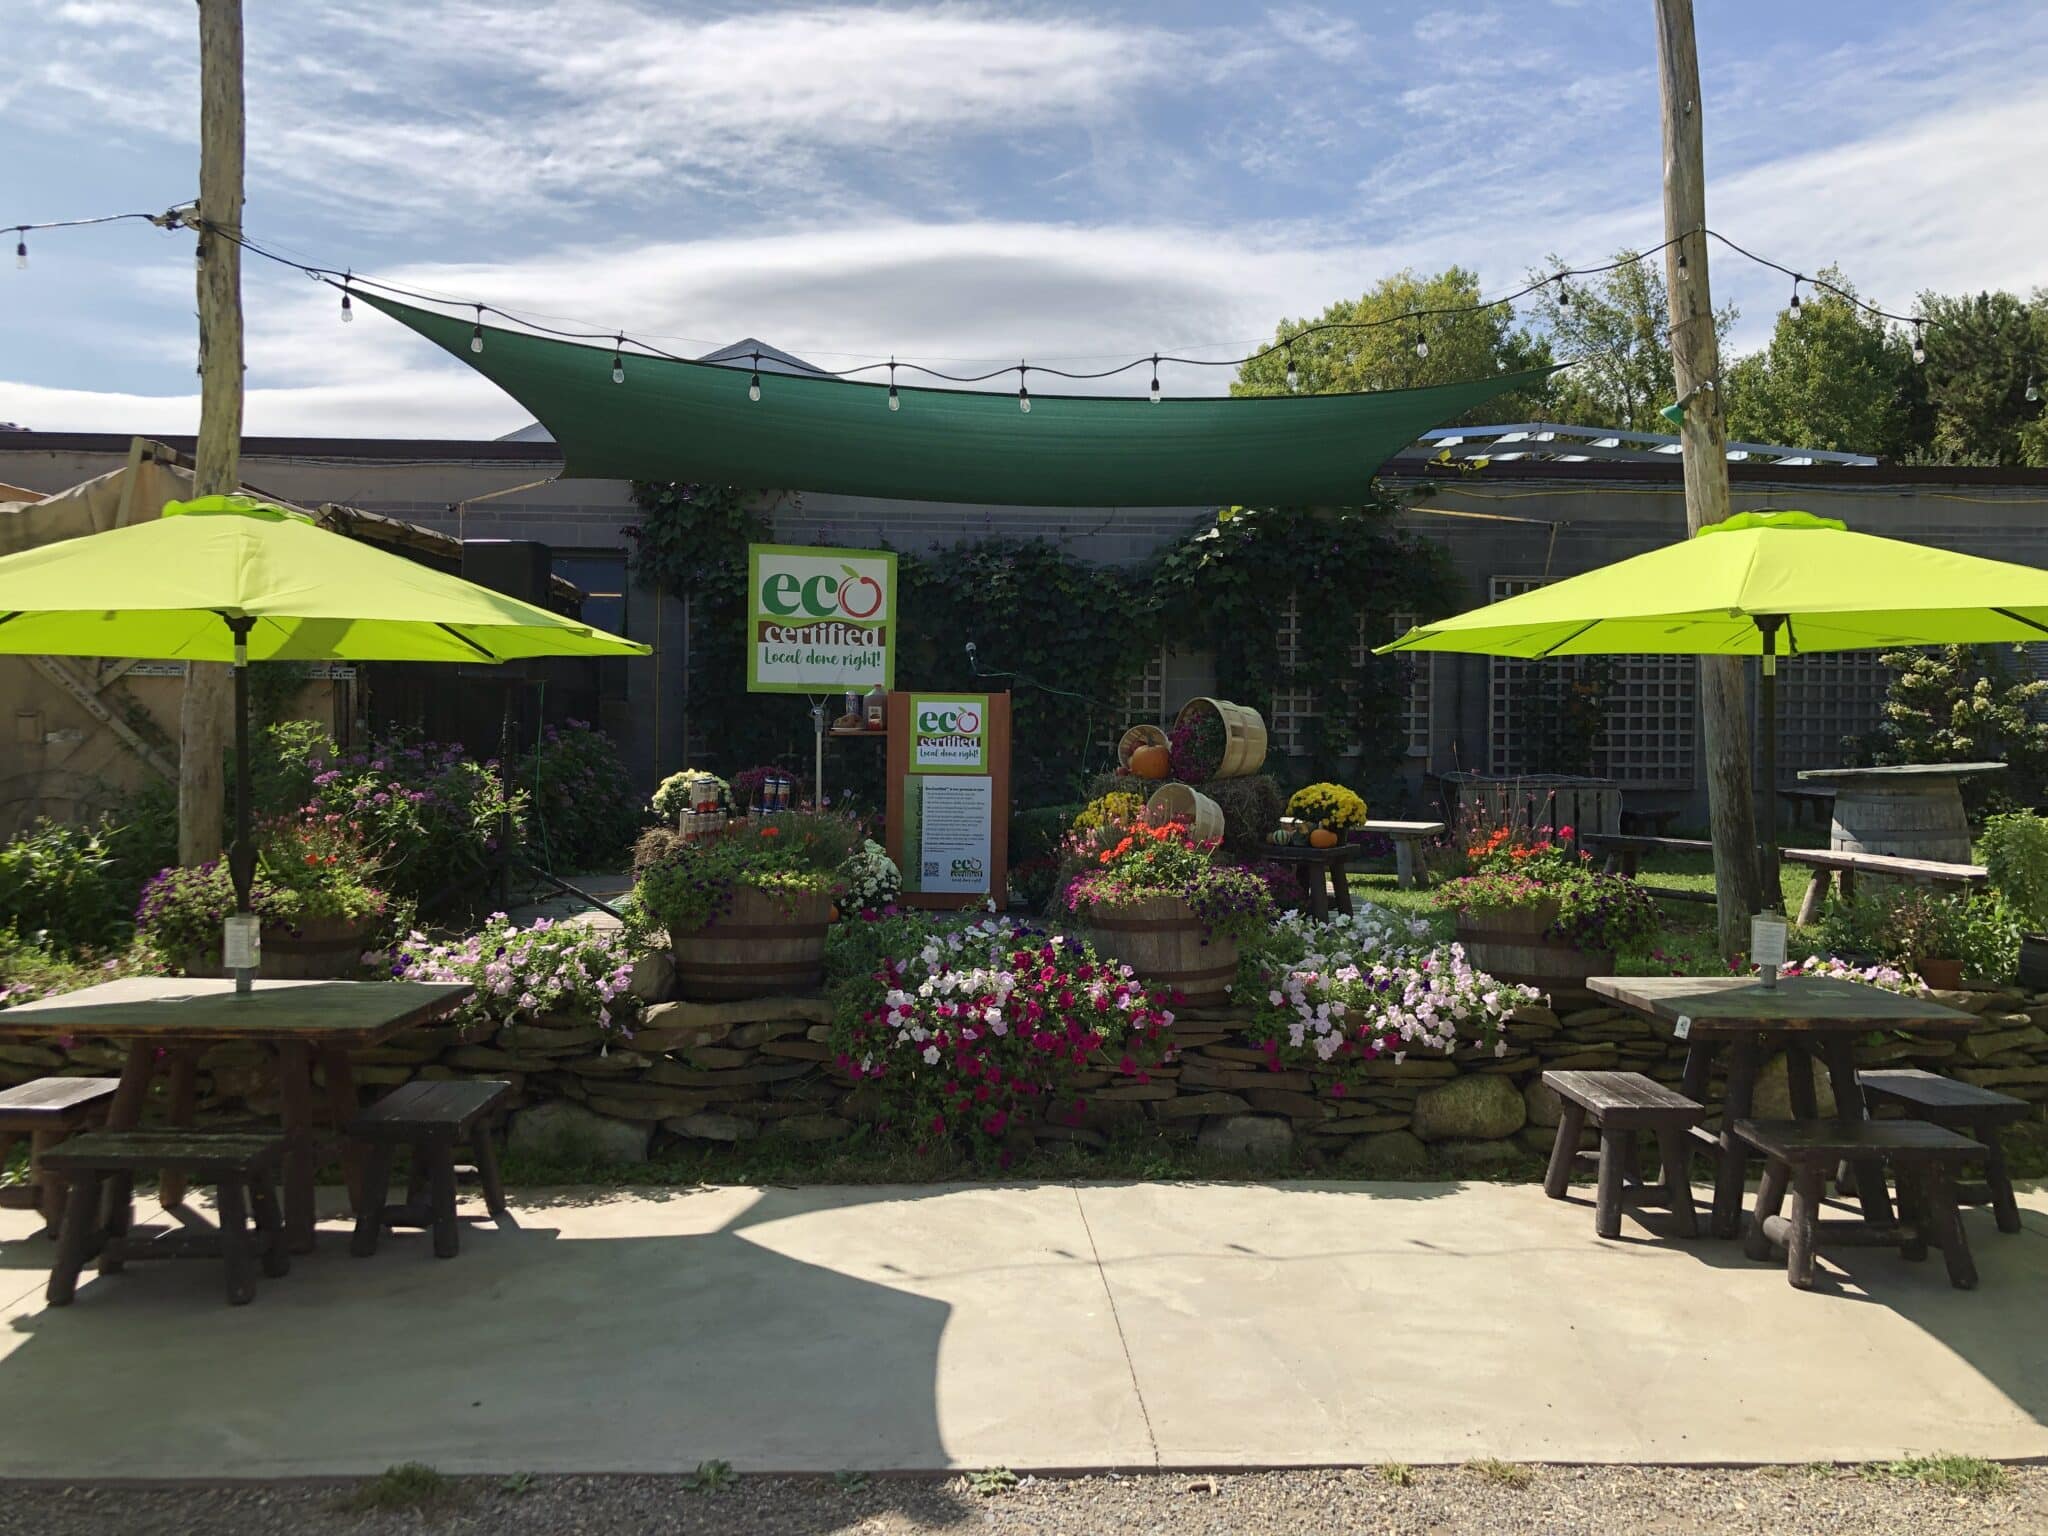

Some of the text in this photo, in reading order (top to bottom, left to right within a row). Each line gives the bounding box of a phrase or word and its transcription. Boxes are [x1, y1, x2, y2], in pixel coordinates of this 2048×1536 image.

[761, 569, 882, 618] eco
[765, 622, 879, 646] certified
[764, 646, 881, 671] Local done right!
[919, 708, 979, 733] eco
[920, 736, 978, 747] certified
[951, 858, 982, 870] eco
